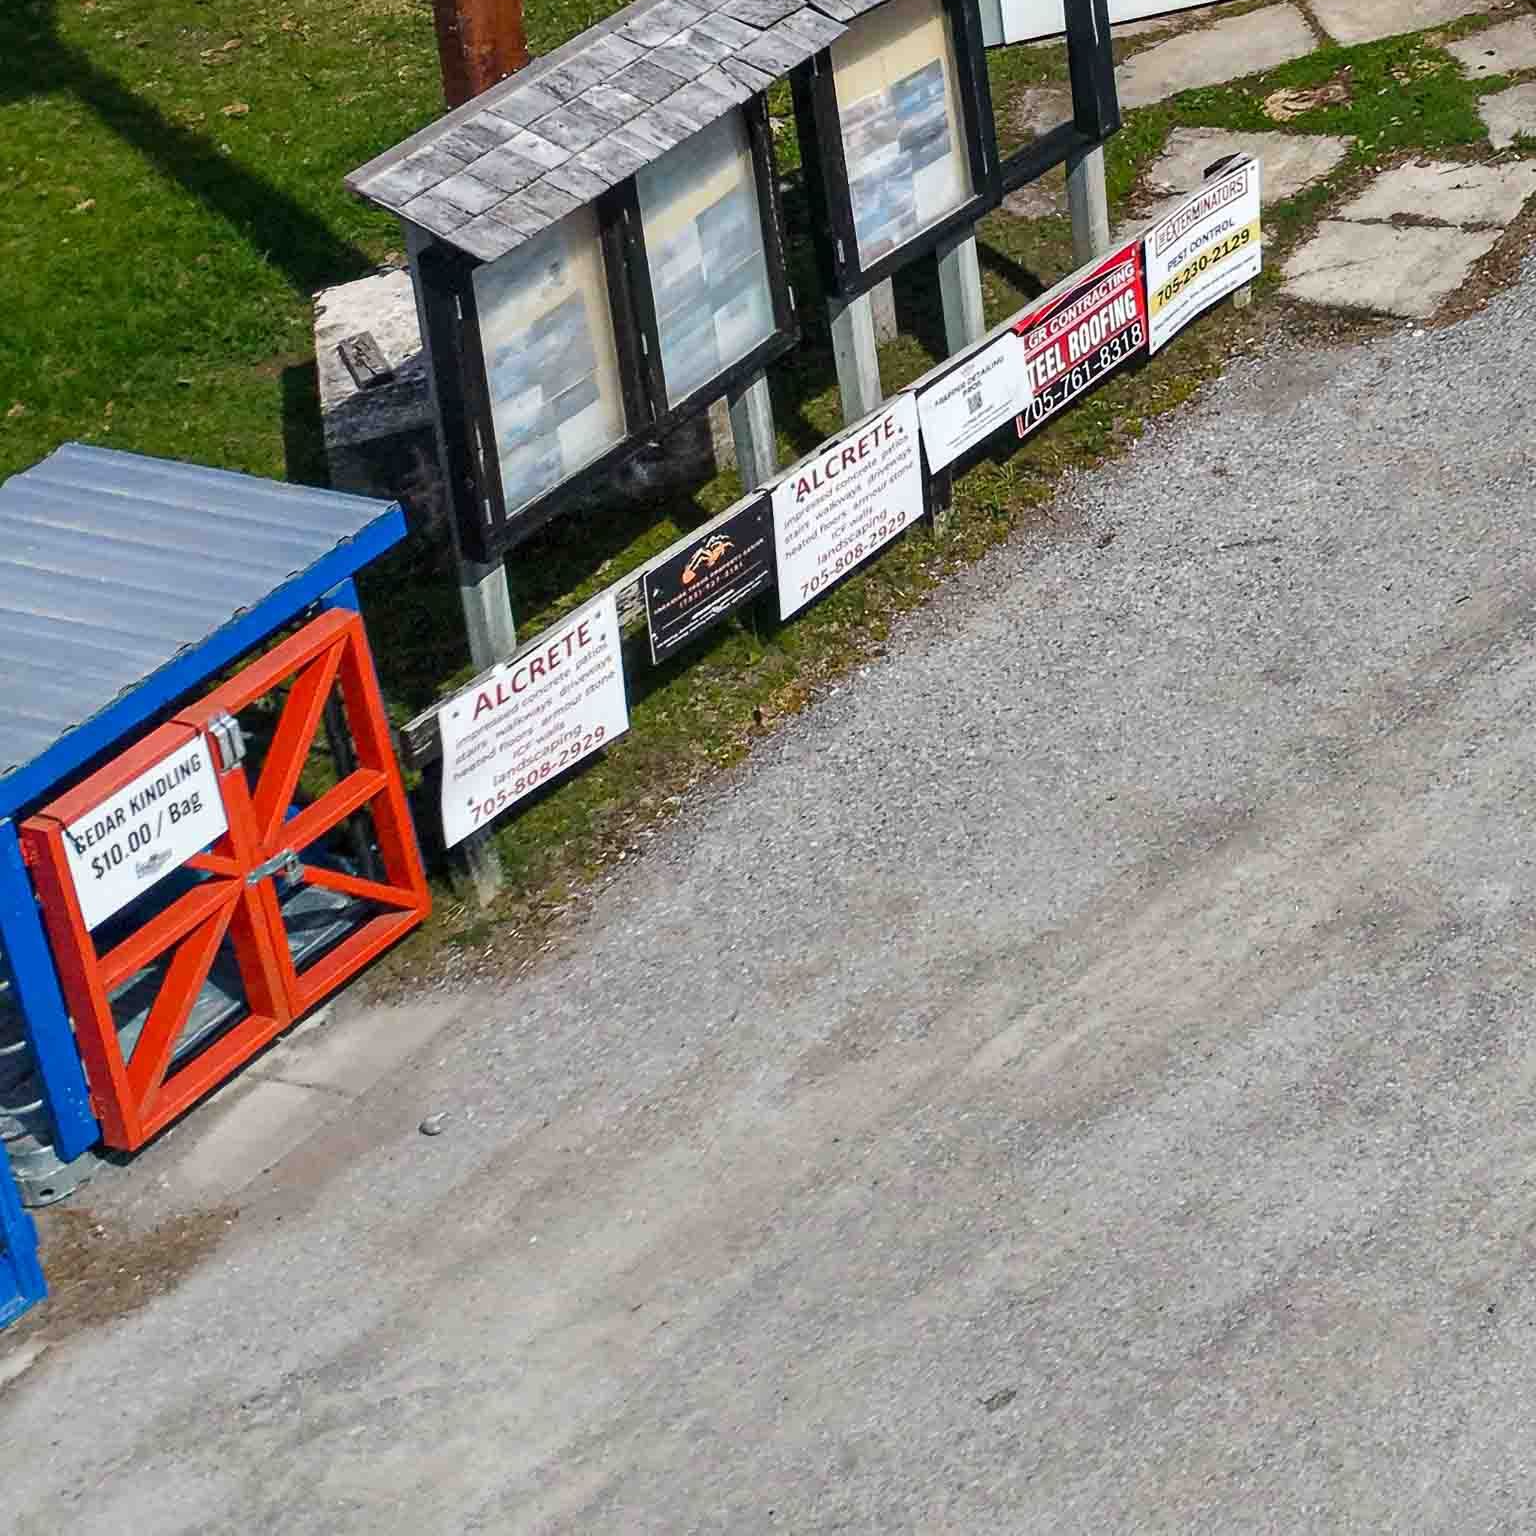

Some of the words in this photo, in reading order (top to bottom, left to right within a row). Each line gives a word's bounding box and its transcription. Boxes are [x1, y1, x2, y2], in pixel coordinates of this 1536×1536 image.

[1165, 176, 1244, 243] EXTERMINATORS
[1167, 248, 1188, 272] PEST
[1190, 216, 1236, 255] CONTROL
[1050, 261, 1136, 334] CONTRACTING
[1156, 228, 1250, 308] 705-230-2129
[1025, 342, 1067, 394] TEEL
[1067, 288, 1138, 363] ROOFING
[796, 414, 896, 501] ALCRETE
[799, 511, 906, 599] 705-808-2929
[816, 508, 888, 566] landscaping
[472, 618, 593, 721] ALCRETE
[471, 724, 607, 825] 705-808-2929
[492, 723, 584, 788] landscaping
[76, 807, 127, 855] CEDAR
[129, 752, 203, 817] KINDLING
[90, 822, 152, 880] $10.00
[157, 810, 163, 839] /
[168, 790, 204, 825] Bag
